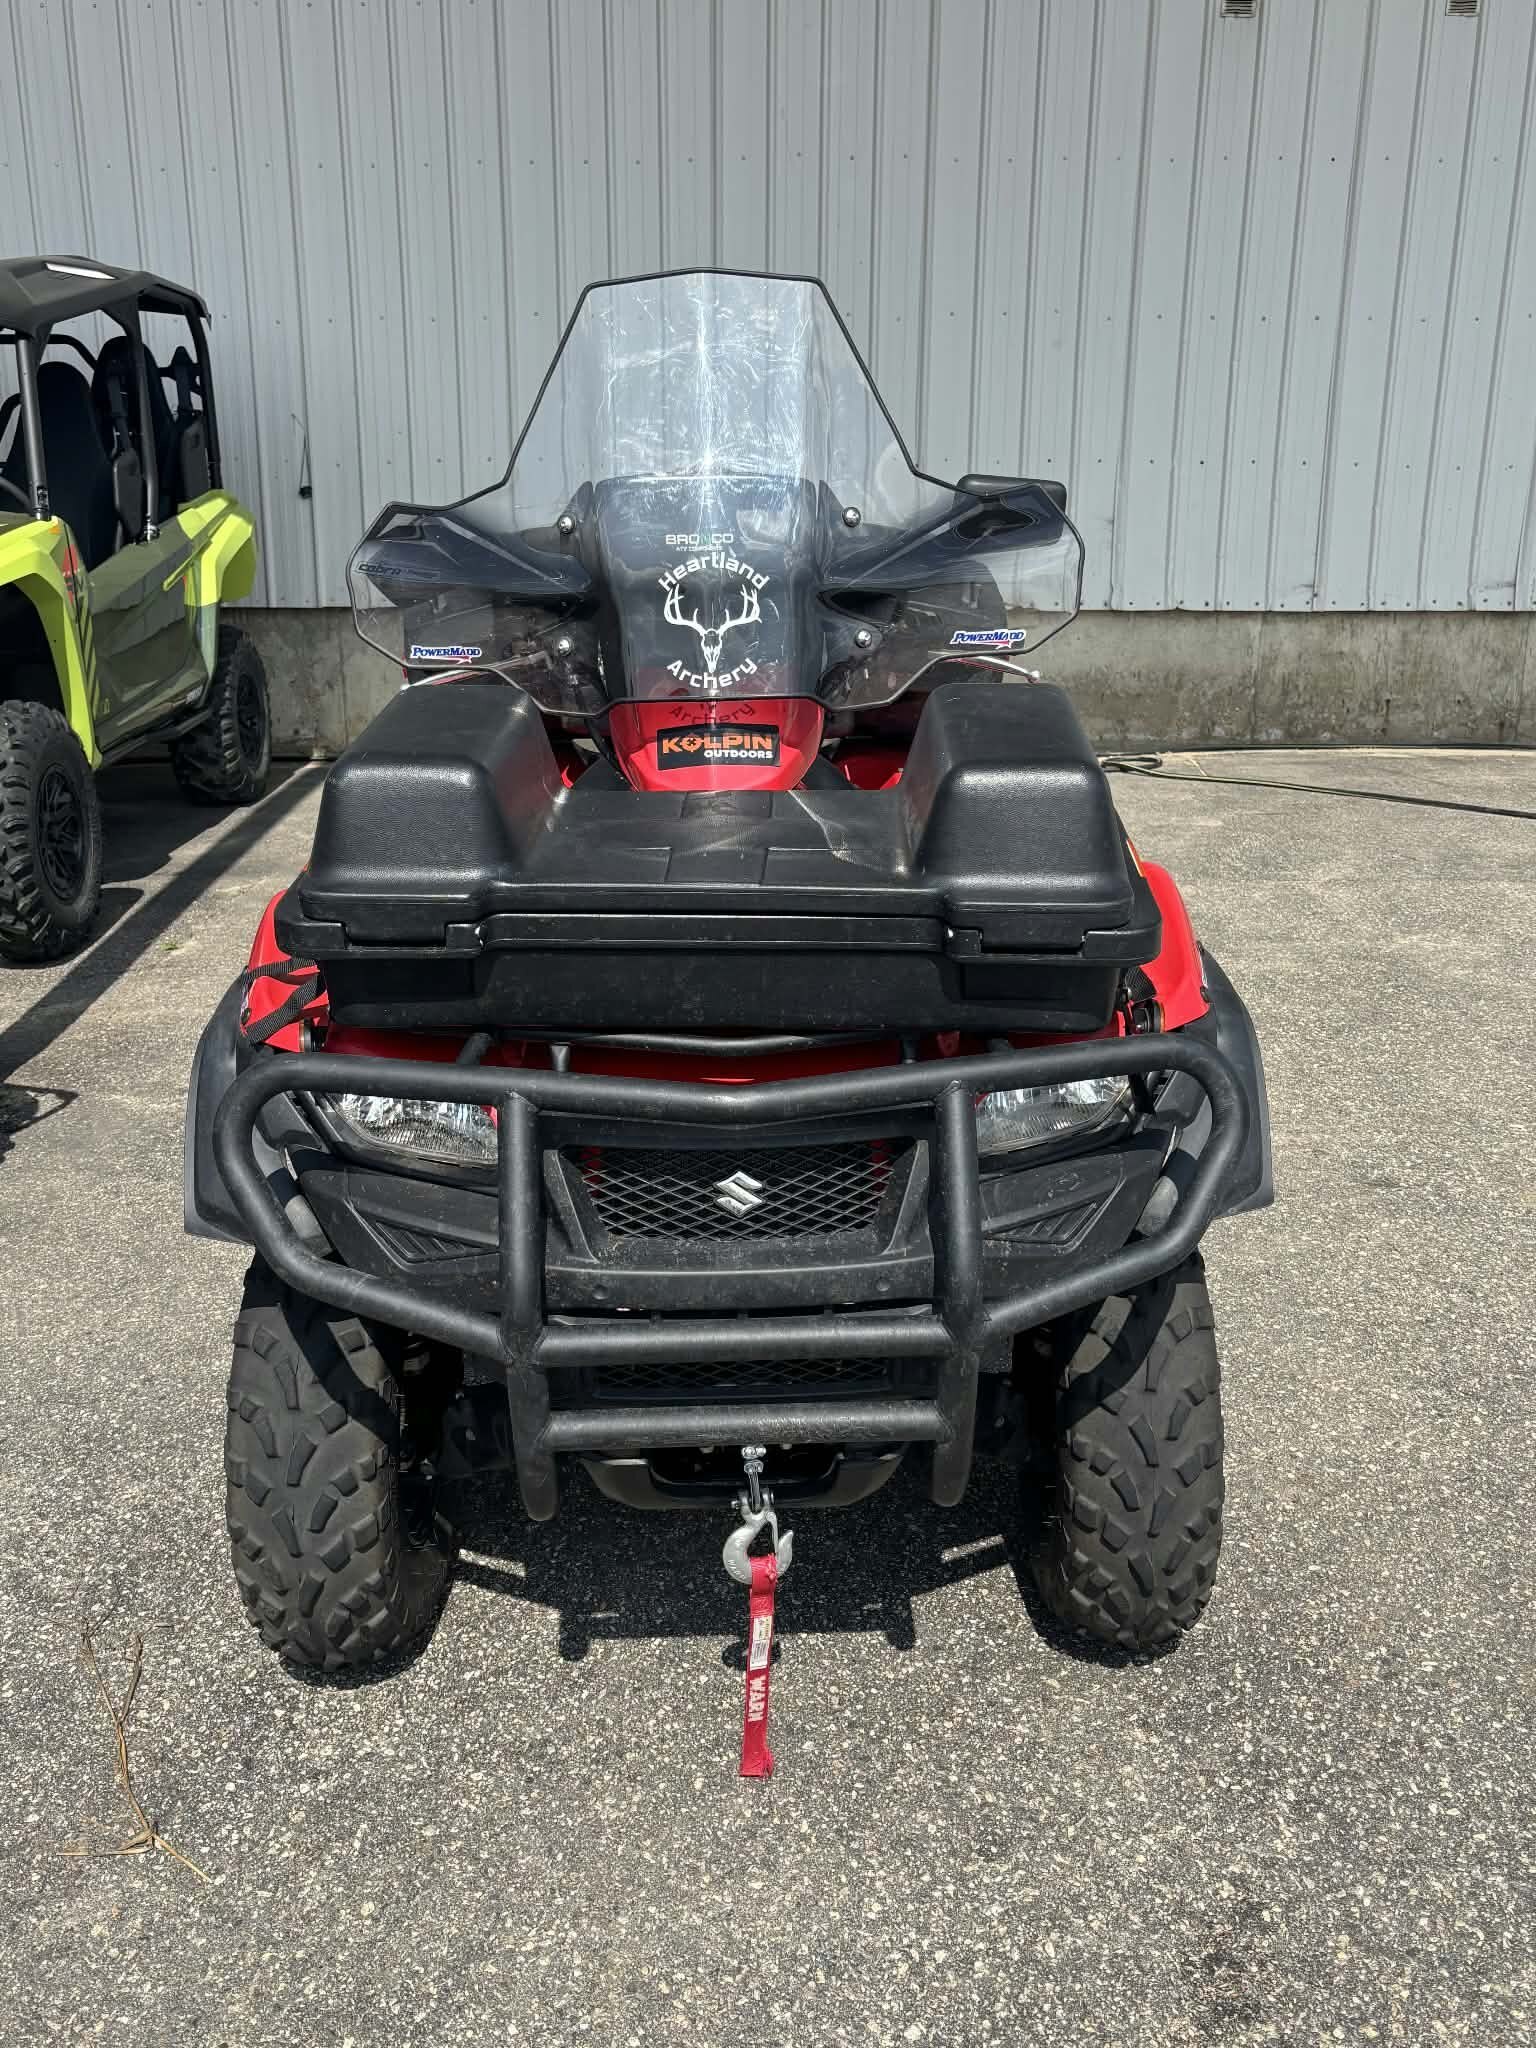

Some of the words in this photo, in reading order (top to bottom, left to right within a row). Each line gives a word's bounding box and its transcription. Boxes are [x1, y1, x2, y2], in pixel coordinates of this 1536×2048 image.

[665, 533, 734, 545] BRONCO
[658, 551, 770, 592] Heartland
[666, 657, 758, 689] Archery
[662, 732, 773, 755] KOLPIN
[703, 749, 774, 760] OUTDOORS
[748, 1674, 767, 1722] WARN
